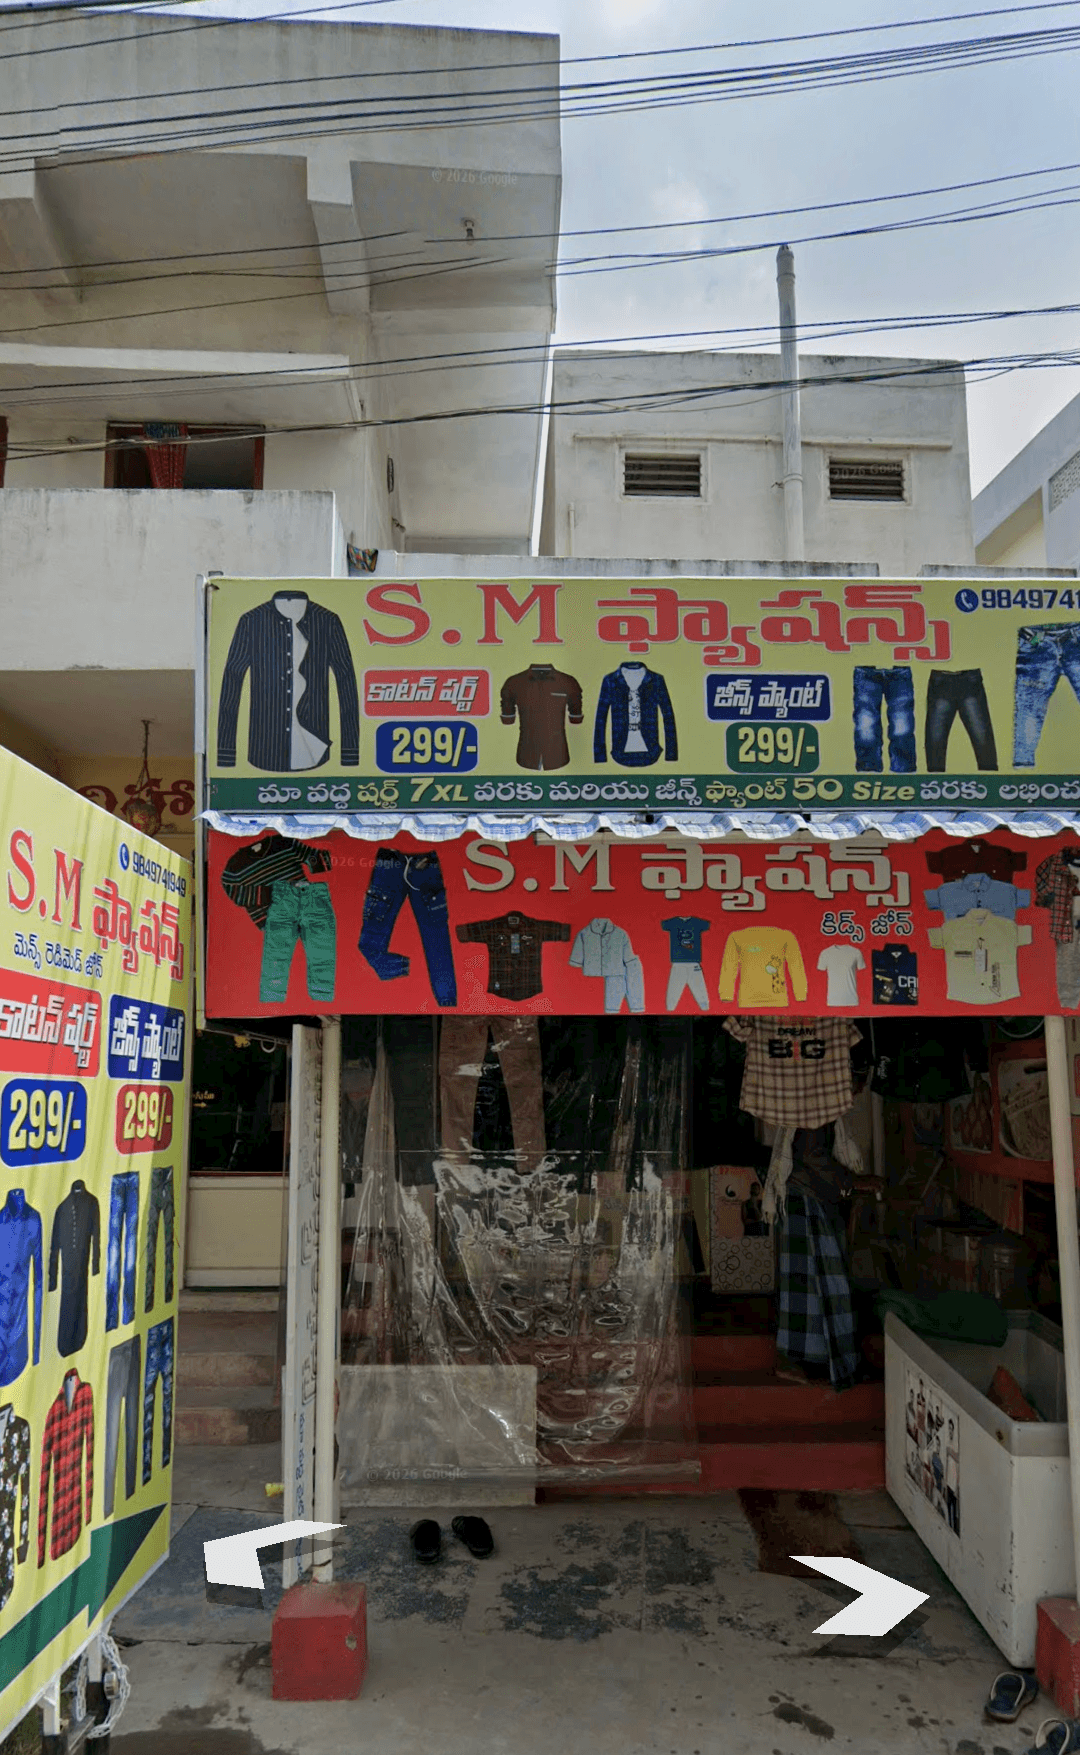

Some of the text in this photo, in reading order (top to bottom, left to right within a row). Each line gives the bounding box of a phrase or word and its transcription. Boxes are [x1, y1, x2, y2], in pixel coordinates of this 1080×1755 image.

[362, 582, 952, 668] S.M ఫ్యాషన్స్
[367, 676, 479, 712] కాటన్ షర్ట్
[391, 727, 477, 767] 299/-
[738, 727, 816, 767] 299/-
[257, 783, 302, 804] మా
[307, 782, 351, 809] వద్ద
[357, 779, 400, 809] షర్ట్
[409, 777, 470, 802] 7XL
[473, 781, 544, 801] వరకు
[549, 781, 650, 801] మరియు
[655, 777, 703, 806] జీన్స్
[792, 778, 844, 801] 50
[852, 781, 915, 801] Size
[920, 780, 988, 800] వరకు
[132, 850, 187, 898] 9849741949
[463, 838, 911, 911] S.M ఫ్యాషన్స్
[8, 830, 184, 981] S.M ఫ్యాషన్స్
[821, 909, 913, 943] కిడ్స్ జోన్
[8, 1089, 81, 1153] 299/-
[124, 1090, 172, 1141] 299/-
